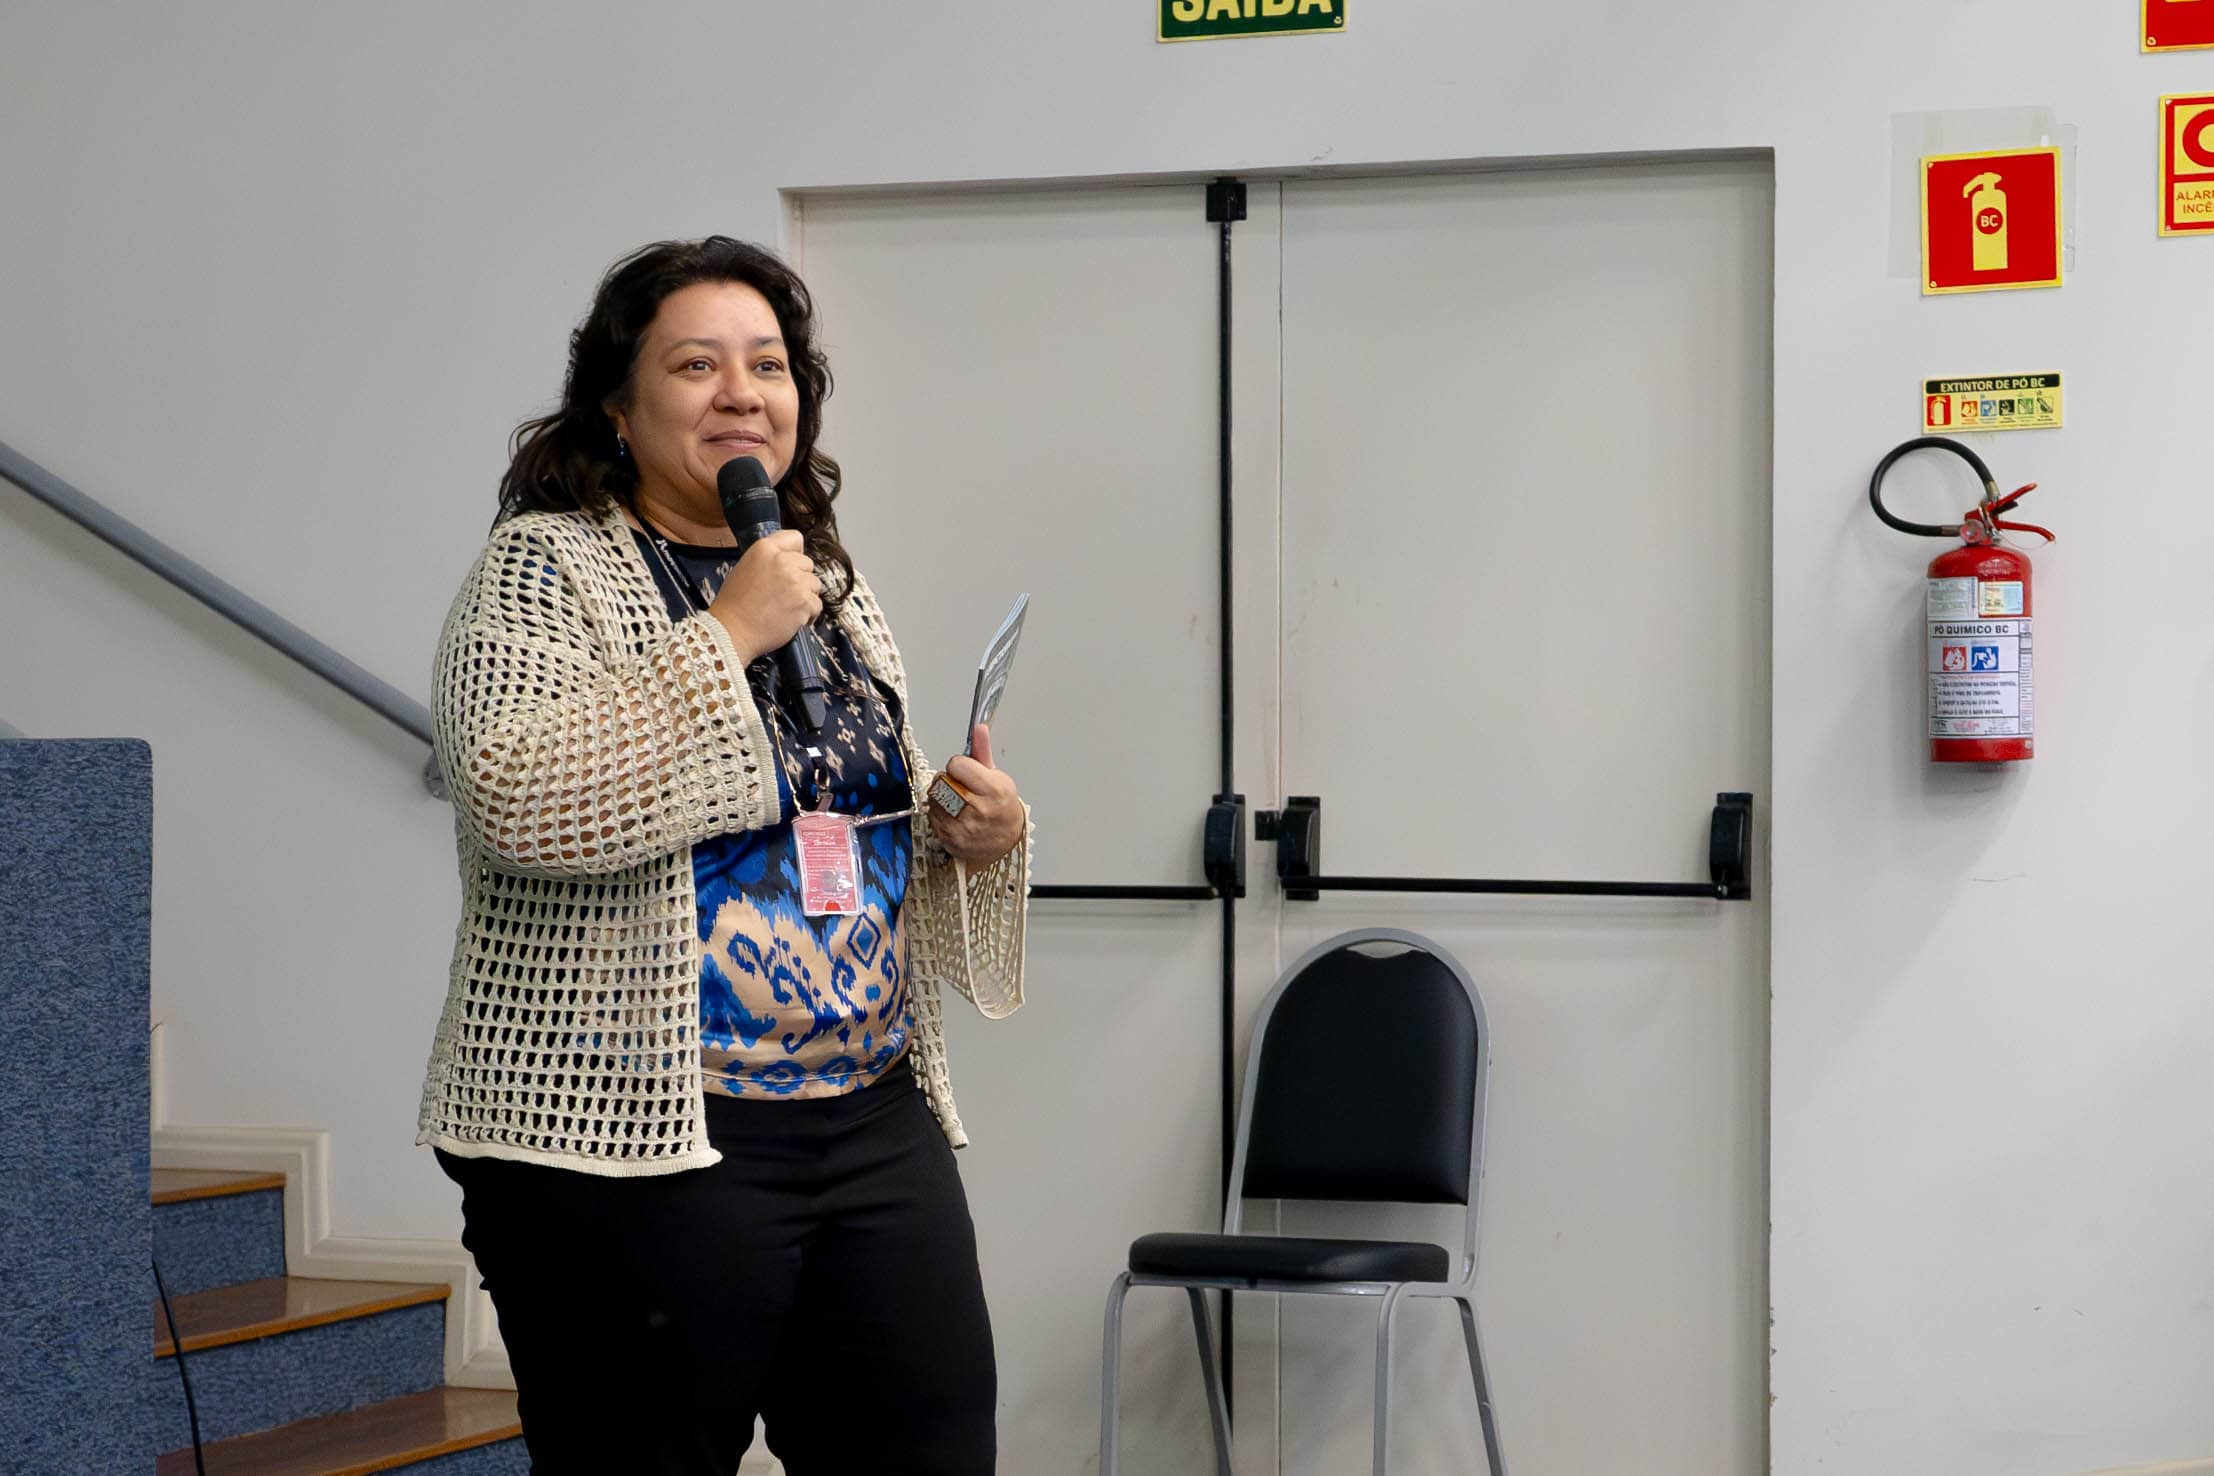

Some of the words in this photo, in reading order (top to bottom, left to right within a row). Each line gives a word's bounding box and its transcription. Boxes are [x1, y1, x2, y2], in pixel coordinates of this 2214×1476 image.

[2176, 190, 2214, 200] ALAR
[1981, 214, 1998, 227] BC
[1940, 381, 1993, 393] EXTINTOR
[1995, 379, 2009, 389] DE
[2013, 376, 2028, 388] PÓ
[2030, 377, 2045, 387] BC
[1995, 624, 2009, 634] BC
